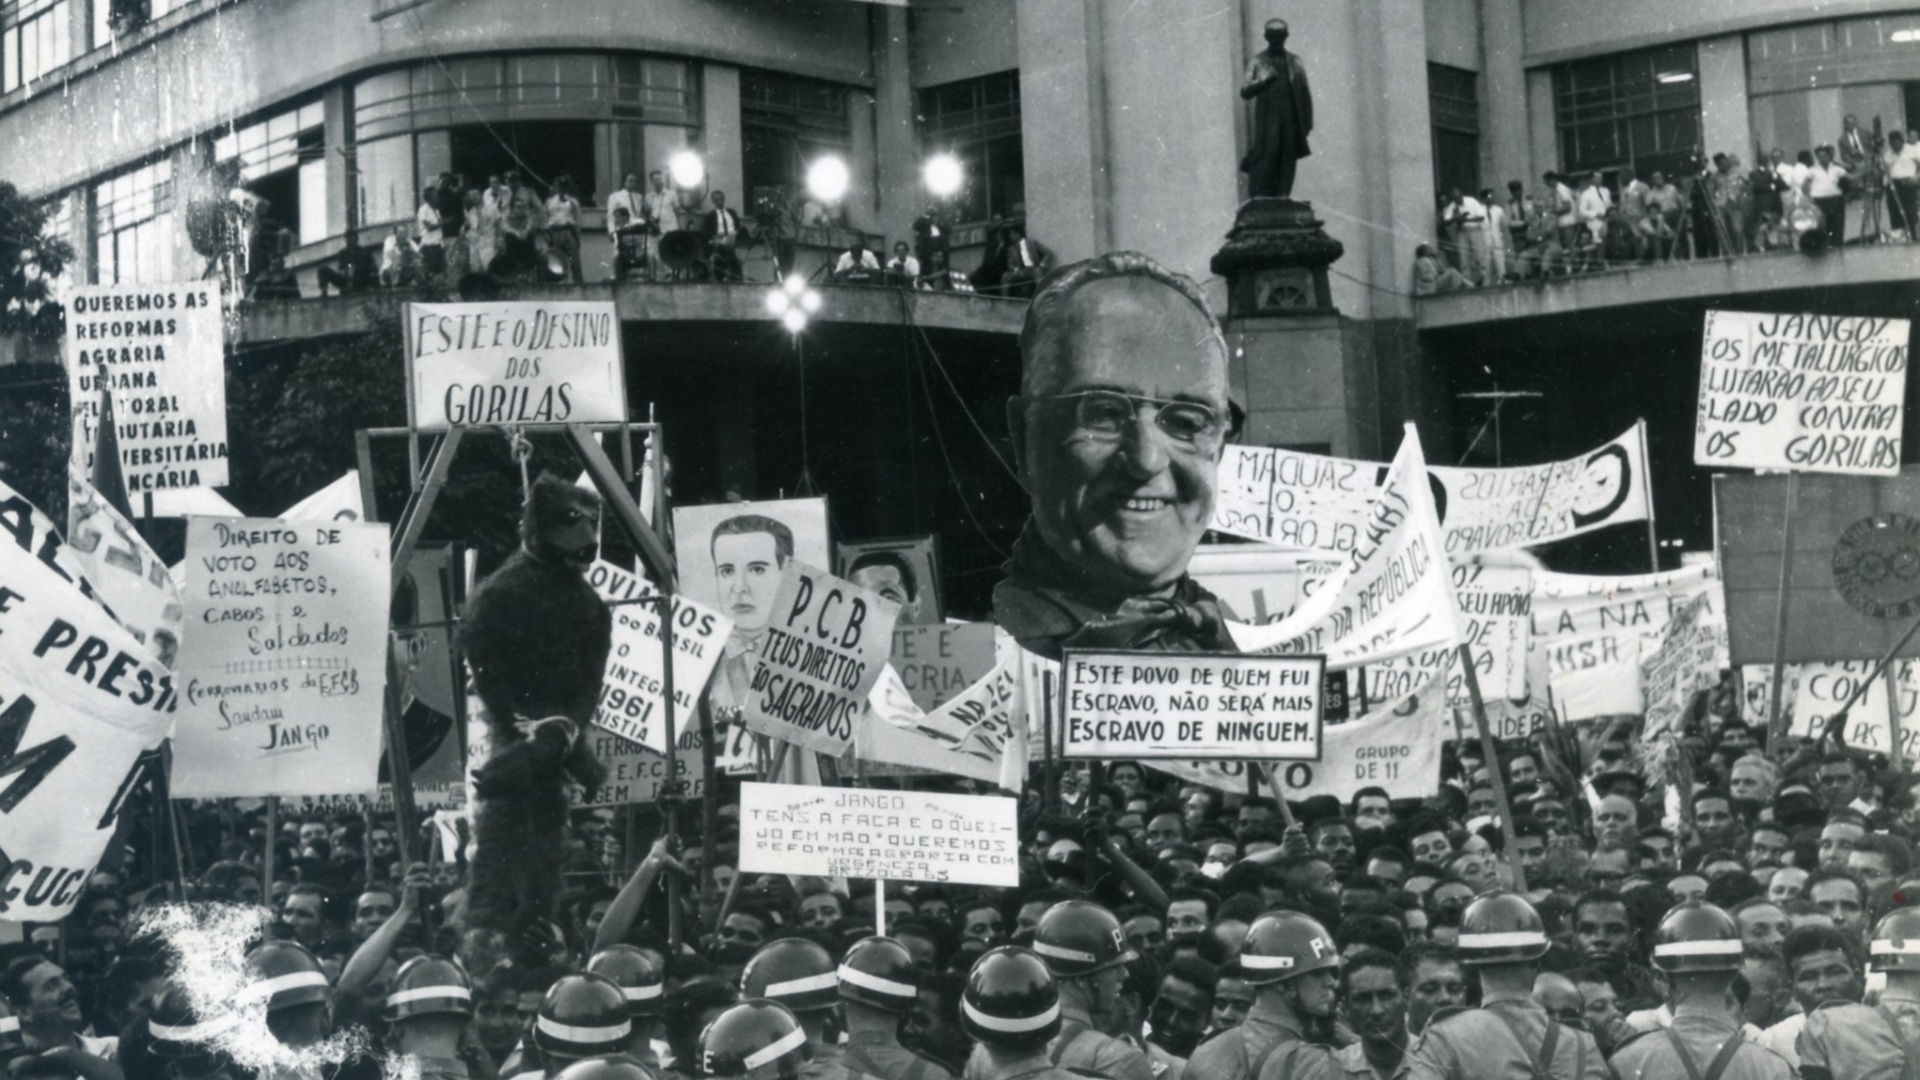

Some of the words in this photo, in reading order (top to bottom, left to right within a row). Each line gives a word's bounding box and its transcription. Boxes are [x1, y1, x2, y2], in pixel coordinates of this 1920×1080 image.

[74, 293, 177, 313] QUEREMOS
[185, 292, 208, 309] AS
[76, 319, 177, 340] REFORMAS
[415, 313, 490, 359] ESTE
[512, 319, 526, 347] O
[527, 309, 611, 350] DESTINO
[1711, 338, 1743, 361] OS
[505, 357, 542, 380] DOS
[1836, 377, 1886, 402] SEU
[444, 382, 573, 425] GORILAS
[1708, 397, 1778, 424] LADO
[1799, 404, 1898, 430] CONTRA
[1706, 431, 1740, 457] OS
[1785, 434, 1900, 469] GORILAS
[214, 523, 298, 548] DIREITO
[316, 529, 341, 546] DE
[202, 556, 256, 573] VOTO
[274, 551, 310, 571] AOS
[1358, 531, 1431, 626] REPÚBLICA
[203, 607, 264, 624] CABOS
[618, 615, 641, 631] DO
[786, 575, 866, 654] P.C.B.
[248, 622, 349, 655] Soldados
[617, 643, 630, 658] O
[762, 627, 803, 669] TEUS
[799, 641, 865, 691] DIREITOS
[1074, 662, 1124, 684] ESTE
[1132, 665, 1179, 684] POVO
[1191, 667, 1213, 685] DE
[1222, 668, 1270, 690] QUEM
[1280, 670, 1309, 686] FUI
[600, 683, 654, 723] 1961
[761, 674, 858, 741] SAGRADOS
[1071, 690, 1158, 715] ESCRAVO,
[1169, 691, 1209, 711] NÃO
[1218, 693, 1266, 716] SERÁ
[1272, 695, 1313, 712] MAIS
[259, 723, 330, 750] JANGO
[1069, 718, 1164, 743] ESCRAVO
[1178, 721, 1203, 742] DE
[1217, 721, 1314, 742] NINGUEM.
[1356, 745, 1410, 760] GRUPO
[1356, 763, 1378, 779] DE
[1386, 762, 1399, 779] 11
[836, 793, 904, 810] JANGO
[749, 808, 809, 824] TENS
[820, 812, 832, 824] A
[841, 813, 899, 828] FACA
[910, 817, 921, 828] E
[756, 828, 783, 840] JO
[792, 829, 819, 842] EM
[889, 834, 1005, 852] QUEREMOS
[977, 854, 1014, 865] COM
[1112, 928, 1123, 952] P
[1310, 937, 1324, 959] P
[703, 1050, 714, 1074] E
